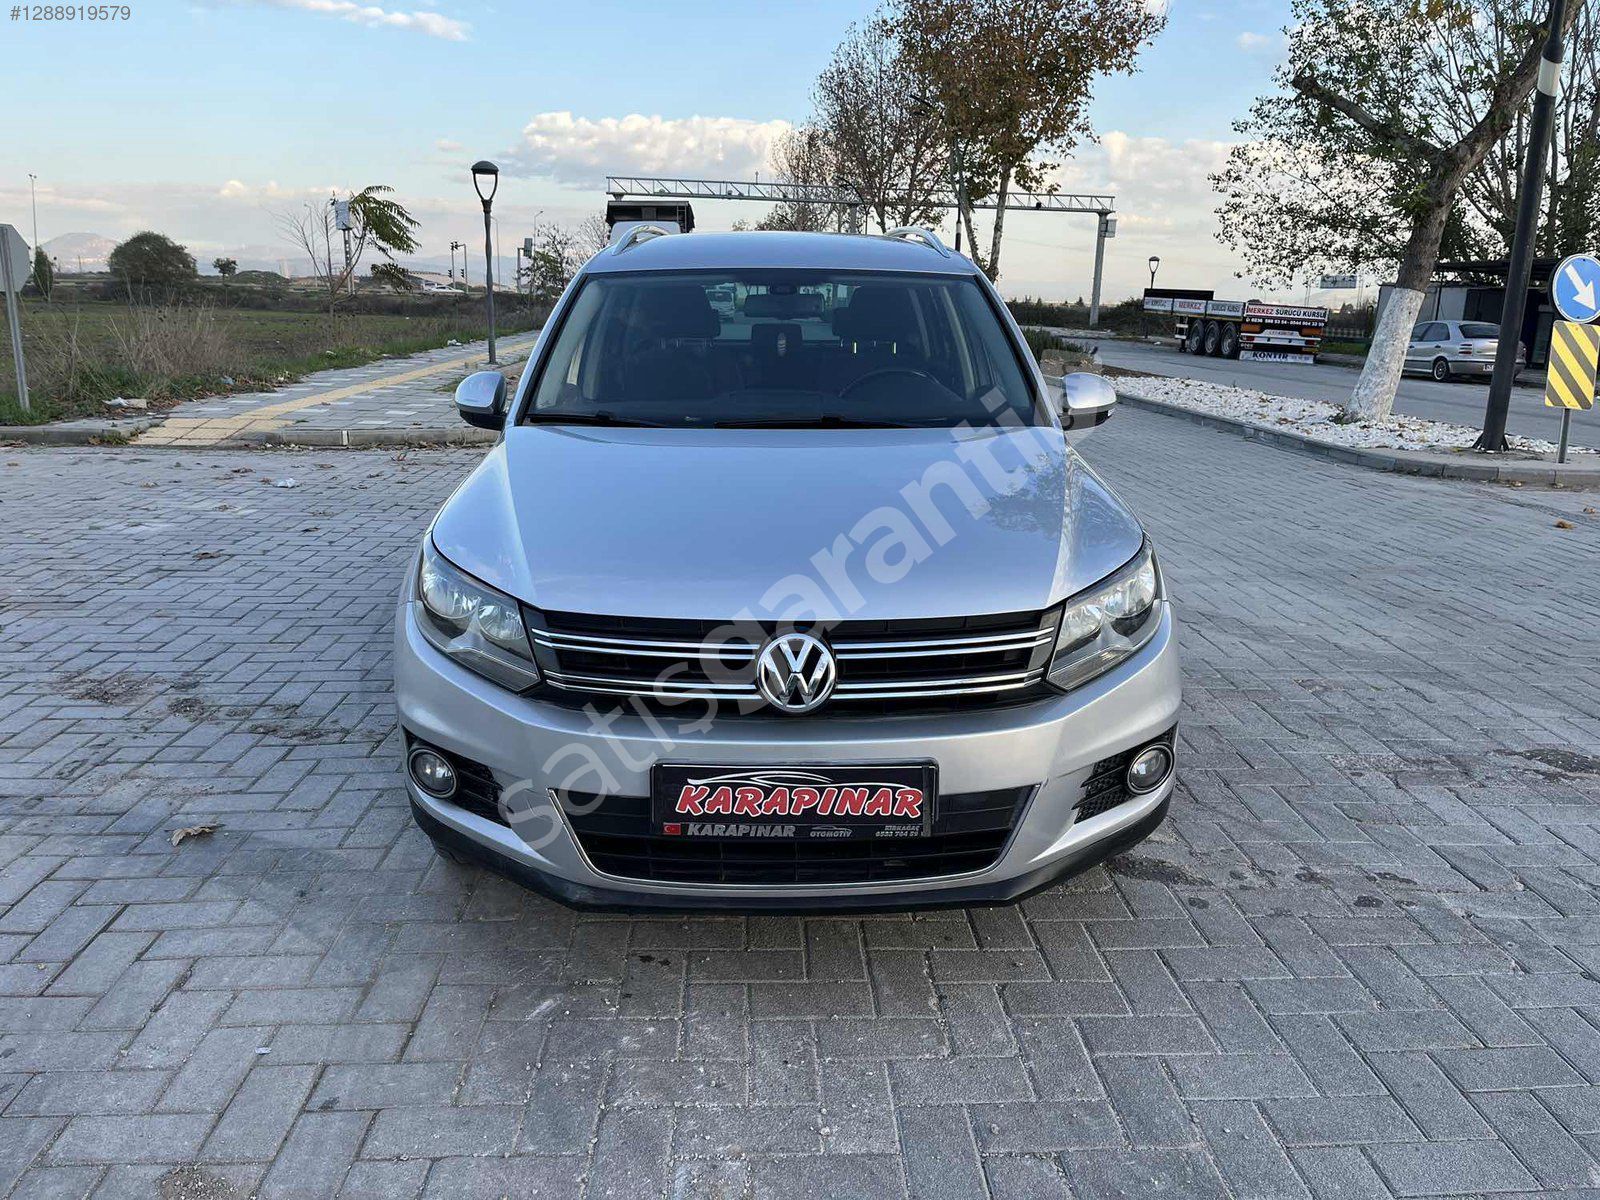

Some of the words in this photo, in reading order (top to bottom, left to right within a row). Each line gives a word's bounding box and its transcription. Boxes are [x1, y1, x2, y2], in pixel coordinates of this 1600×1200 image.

[1247, 306, 1274, 315] MERKEZ
[675, 785, 924, 818] KARAPINAR
[687, 822, 796, 838] KARAPINAR
